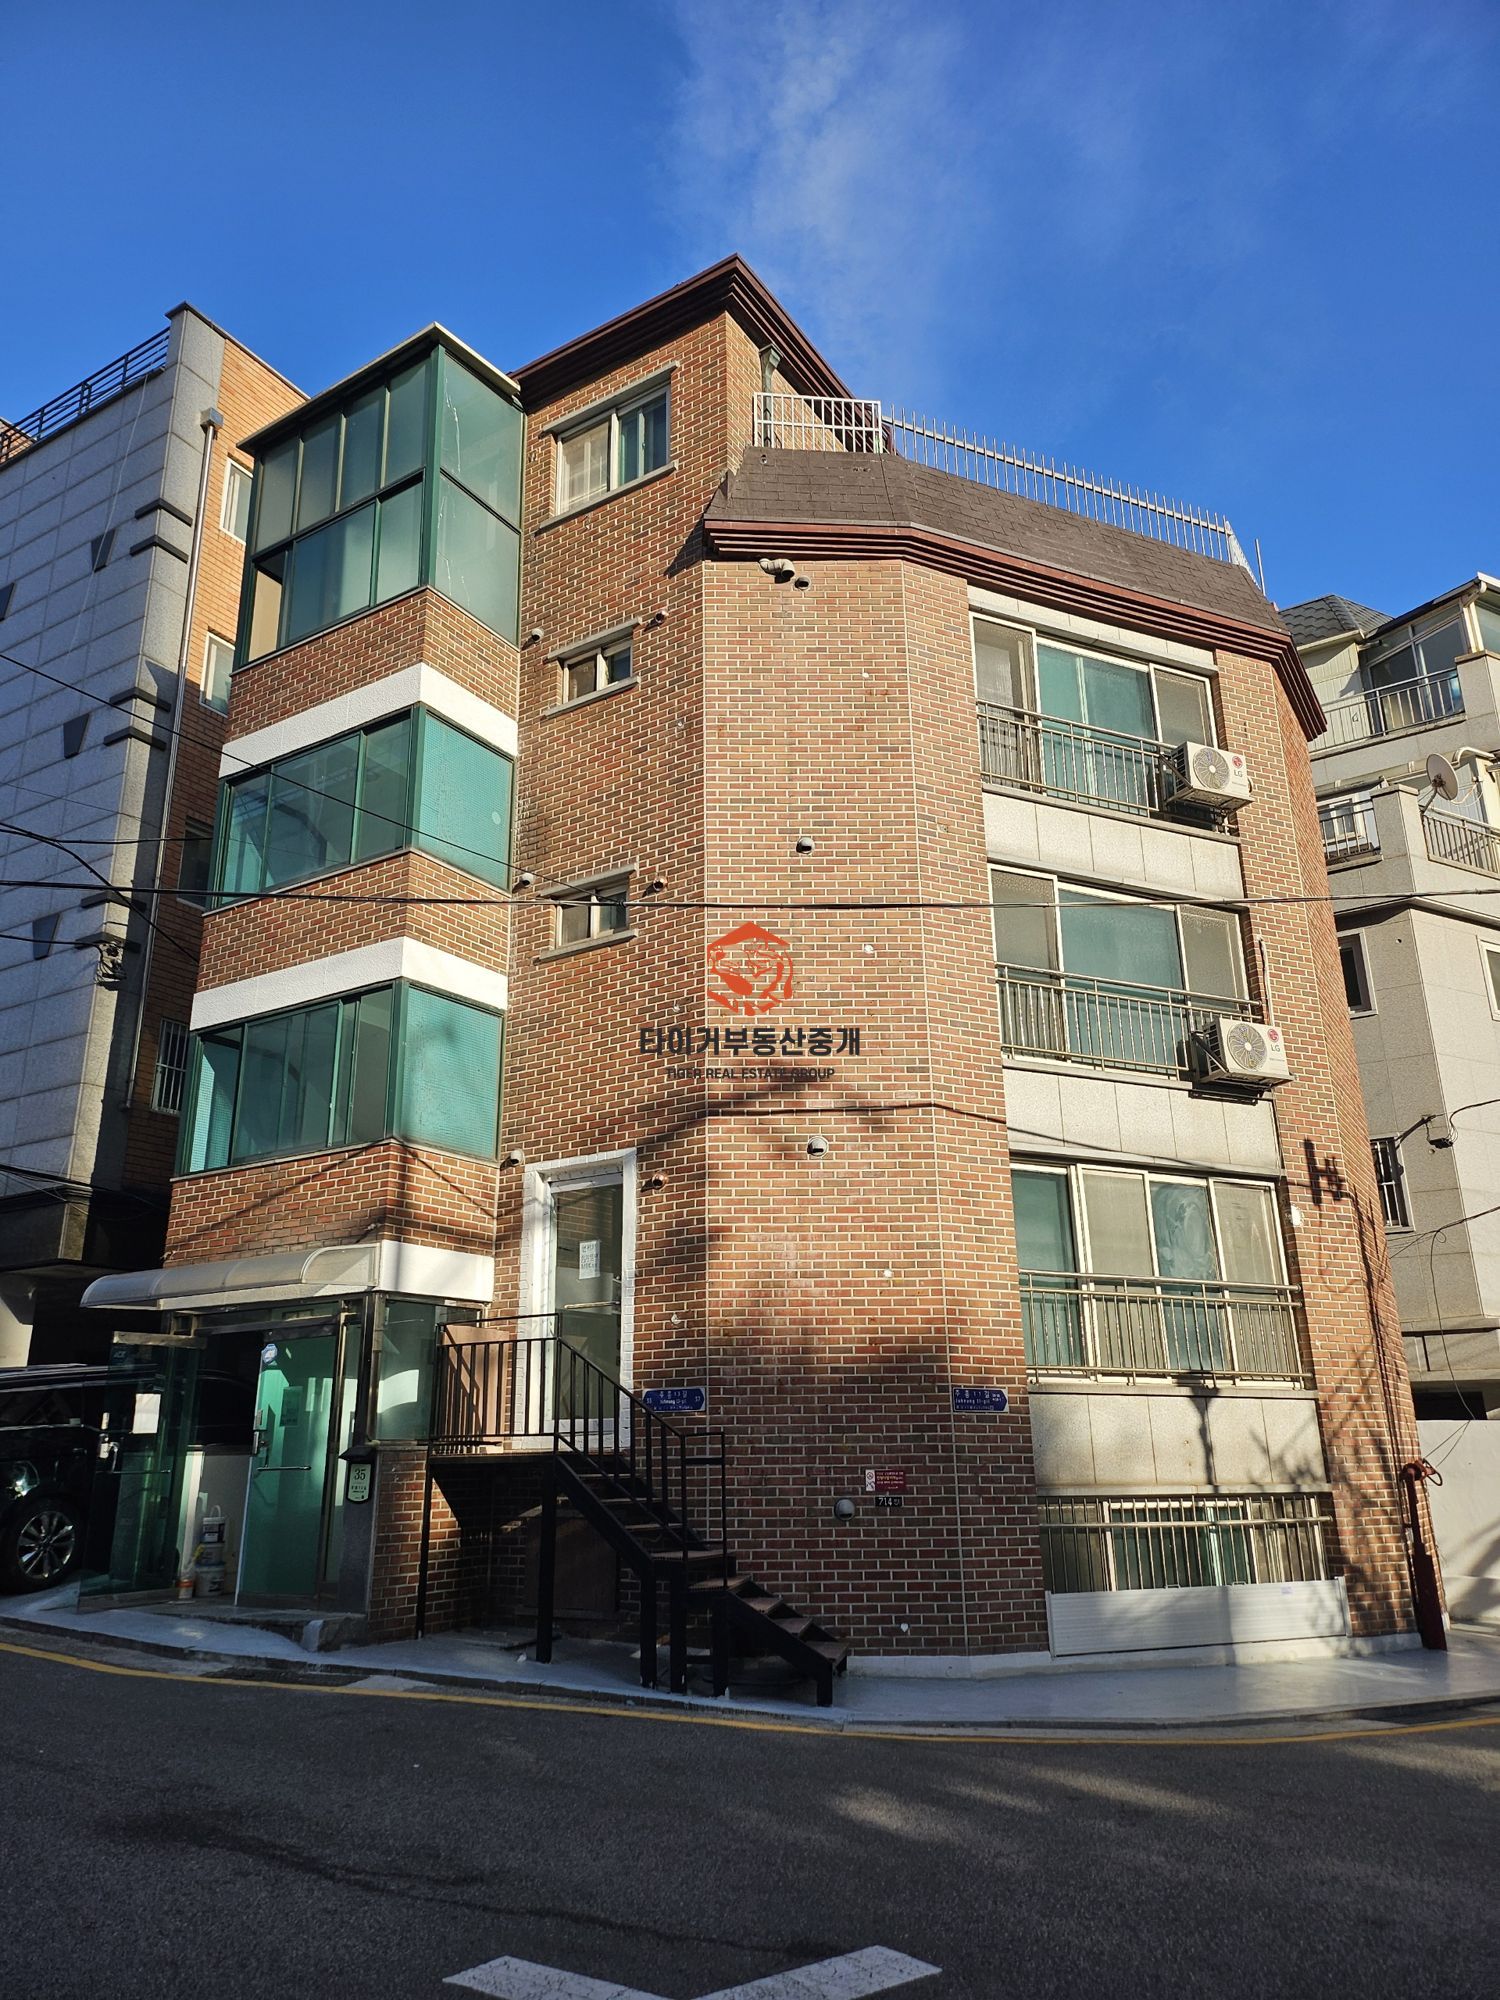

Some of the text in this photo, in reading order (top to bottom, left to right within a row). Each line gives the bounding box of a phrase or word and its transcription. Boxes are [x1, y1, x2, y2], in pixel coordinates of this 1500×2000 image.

[1233, 769, 1243, 777] LG
[1270, 1044, 1280, 1052] LG
[354, 1468, 367, 1480] 35
